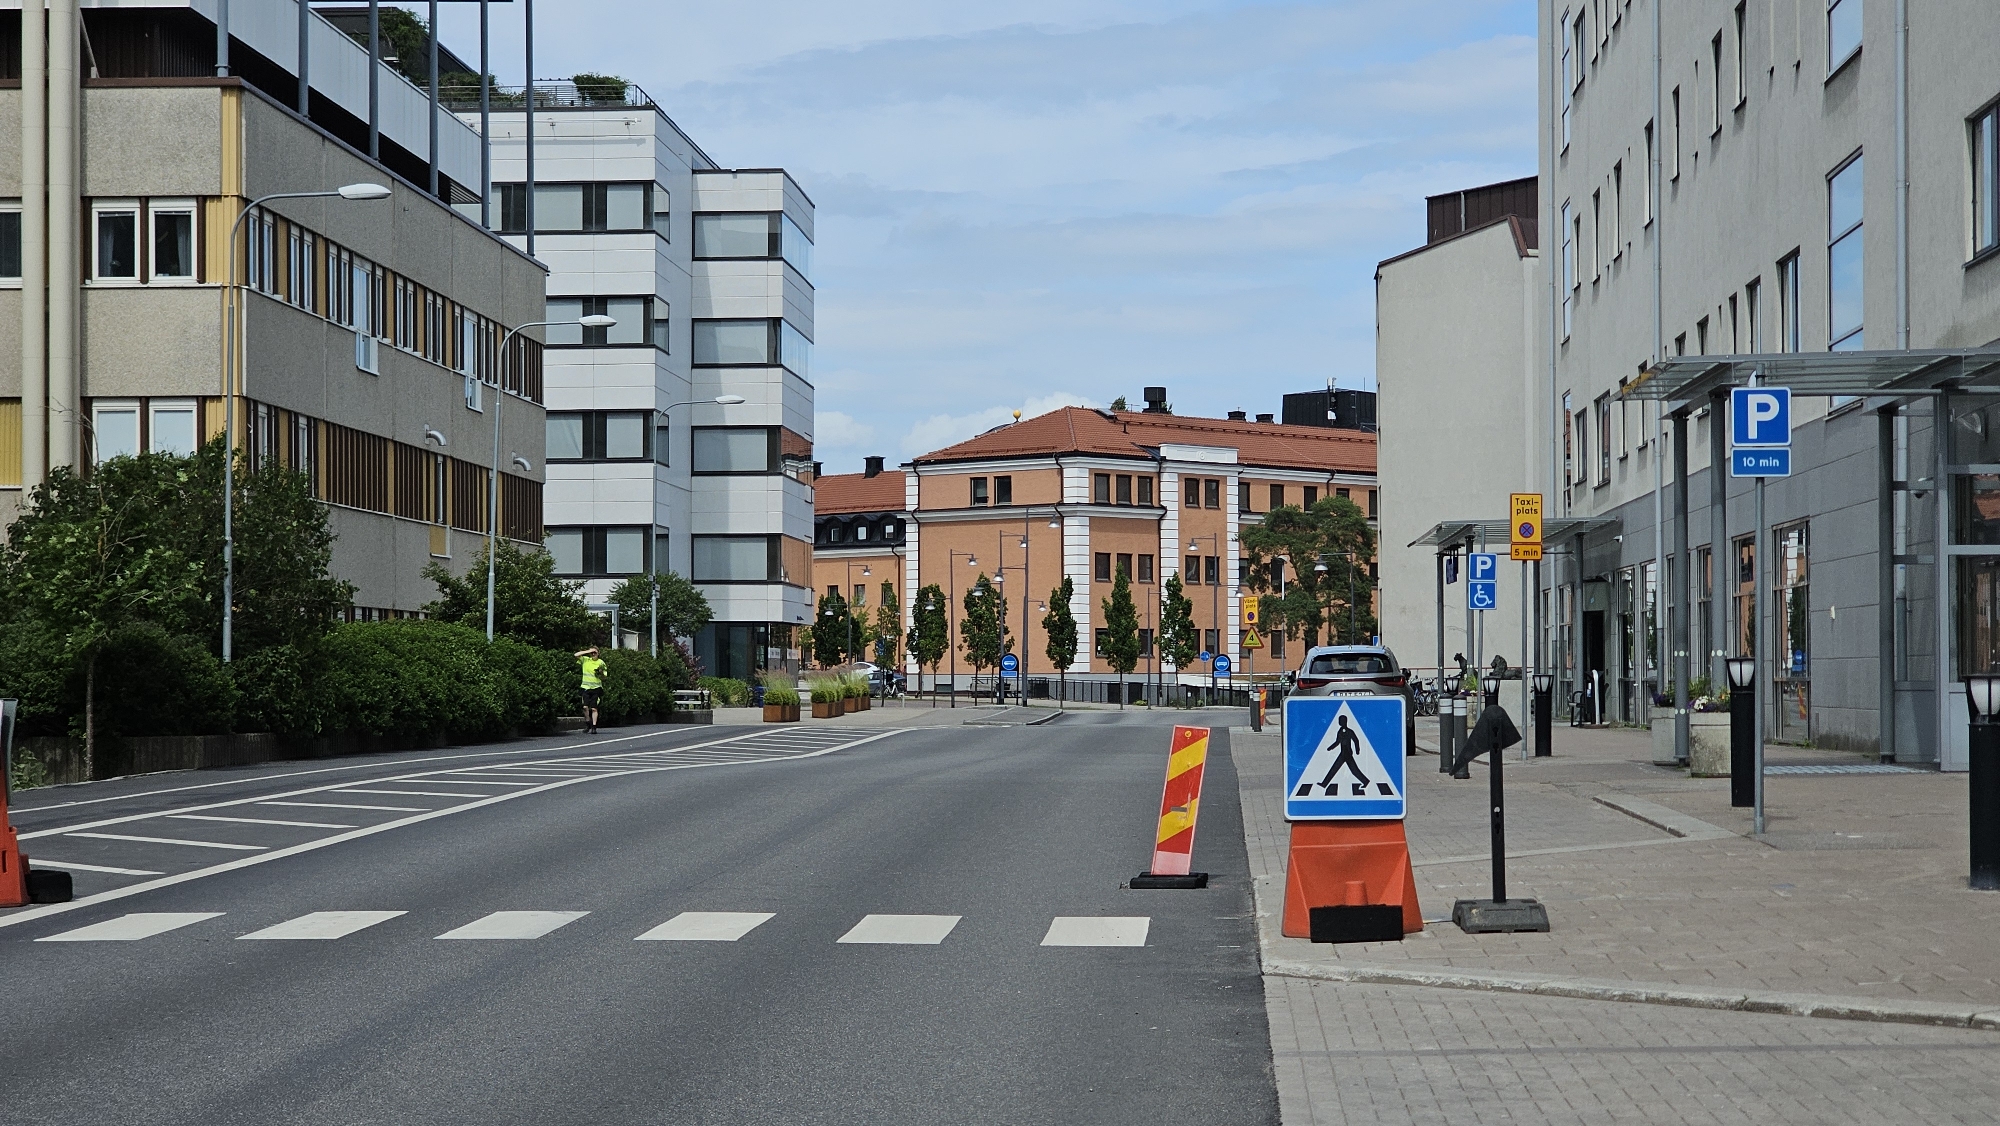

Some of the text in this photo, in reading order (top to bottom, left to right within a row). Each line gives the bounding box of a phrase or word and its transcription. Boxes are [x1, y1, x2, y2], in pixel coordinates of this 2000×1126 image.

[1748, 394, 1780, 440] P
[1743, 457, 1780, 467] 10 min
[1515, 498, 1539, 506] Taxi-
[1516, 507, 1539, 516] plats
[1476, 556, 1492, 578] P
[1249, 634, 1254, 642] 4
